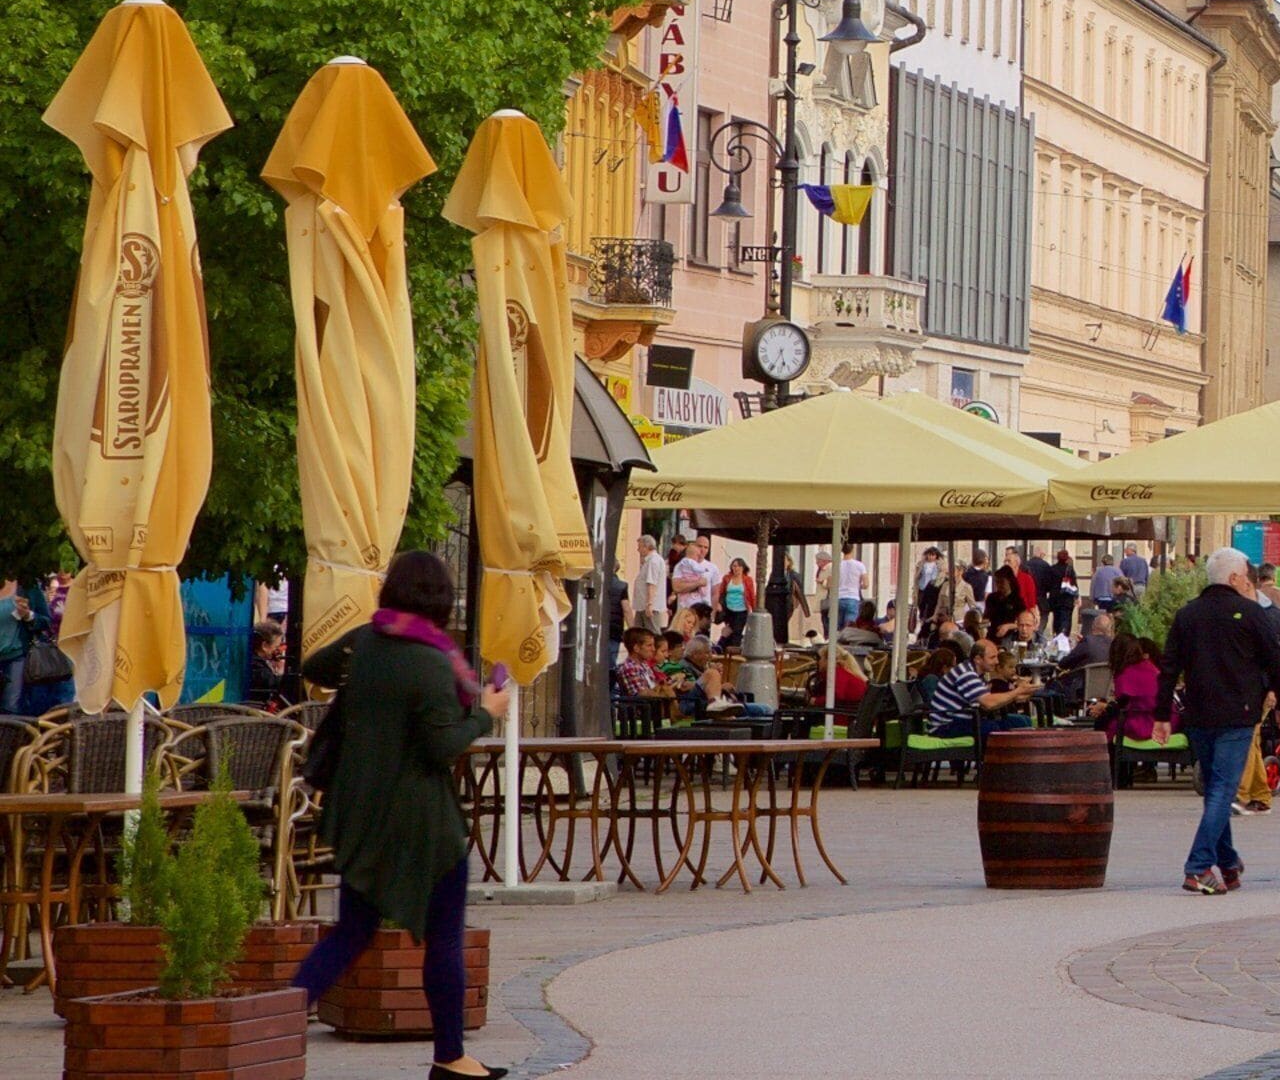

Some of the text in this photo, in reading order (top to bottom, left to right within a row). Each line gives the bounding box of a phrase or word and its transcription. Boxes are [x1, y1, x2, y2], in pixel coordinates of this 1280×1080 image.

[112, 304, 142, 450] STAROPRAMEN
[666, 389, 724, 426] NABYTOK
[625, 482, 686, 502] oca-Cola
[940, 488, 1005, 508] Coca-Cola
[1090, 483, 1157, 501] Coca-Cola
